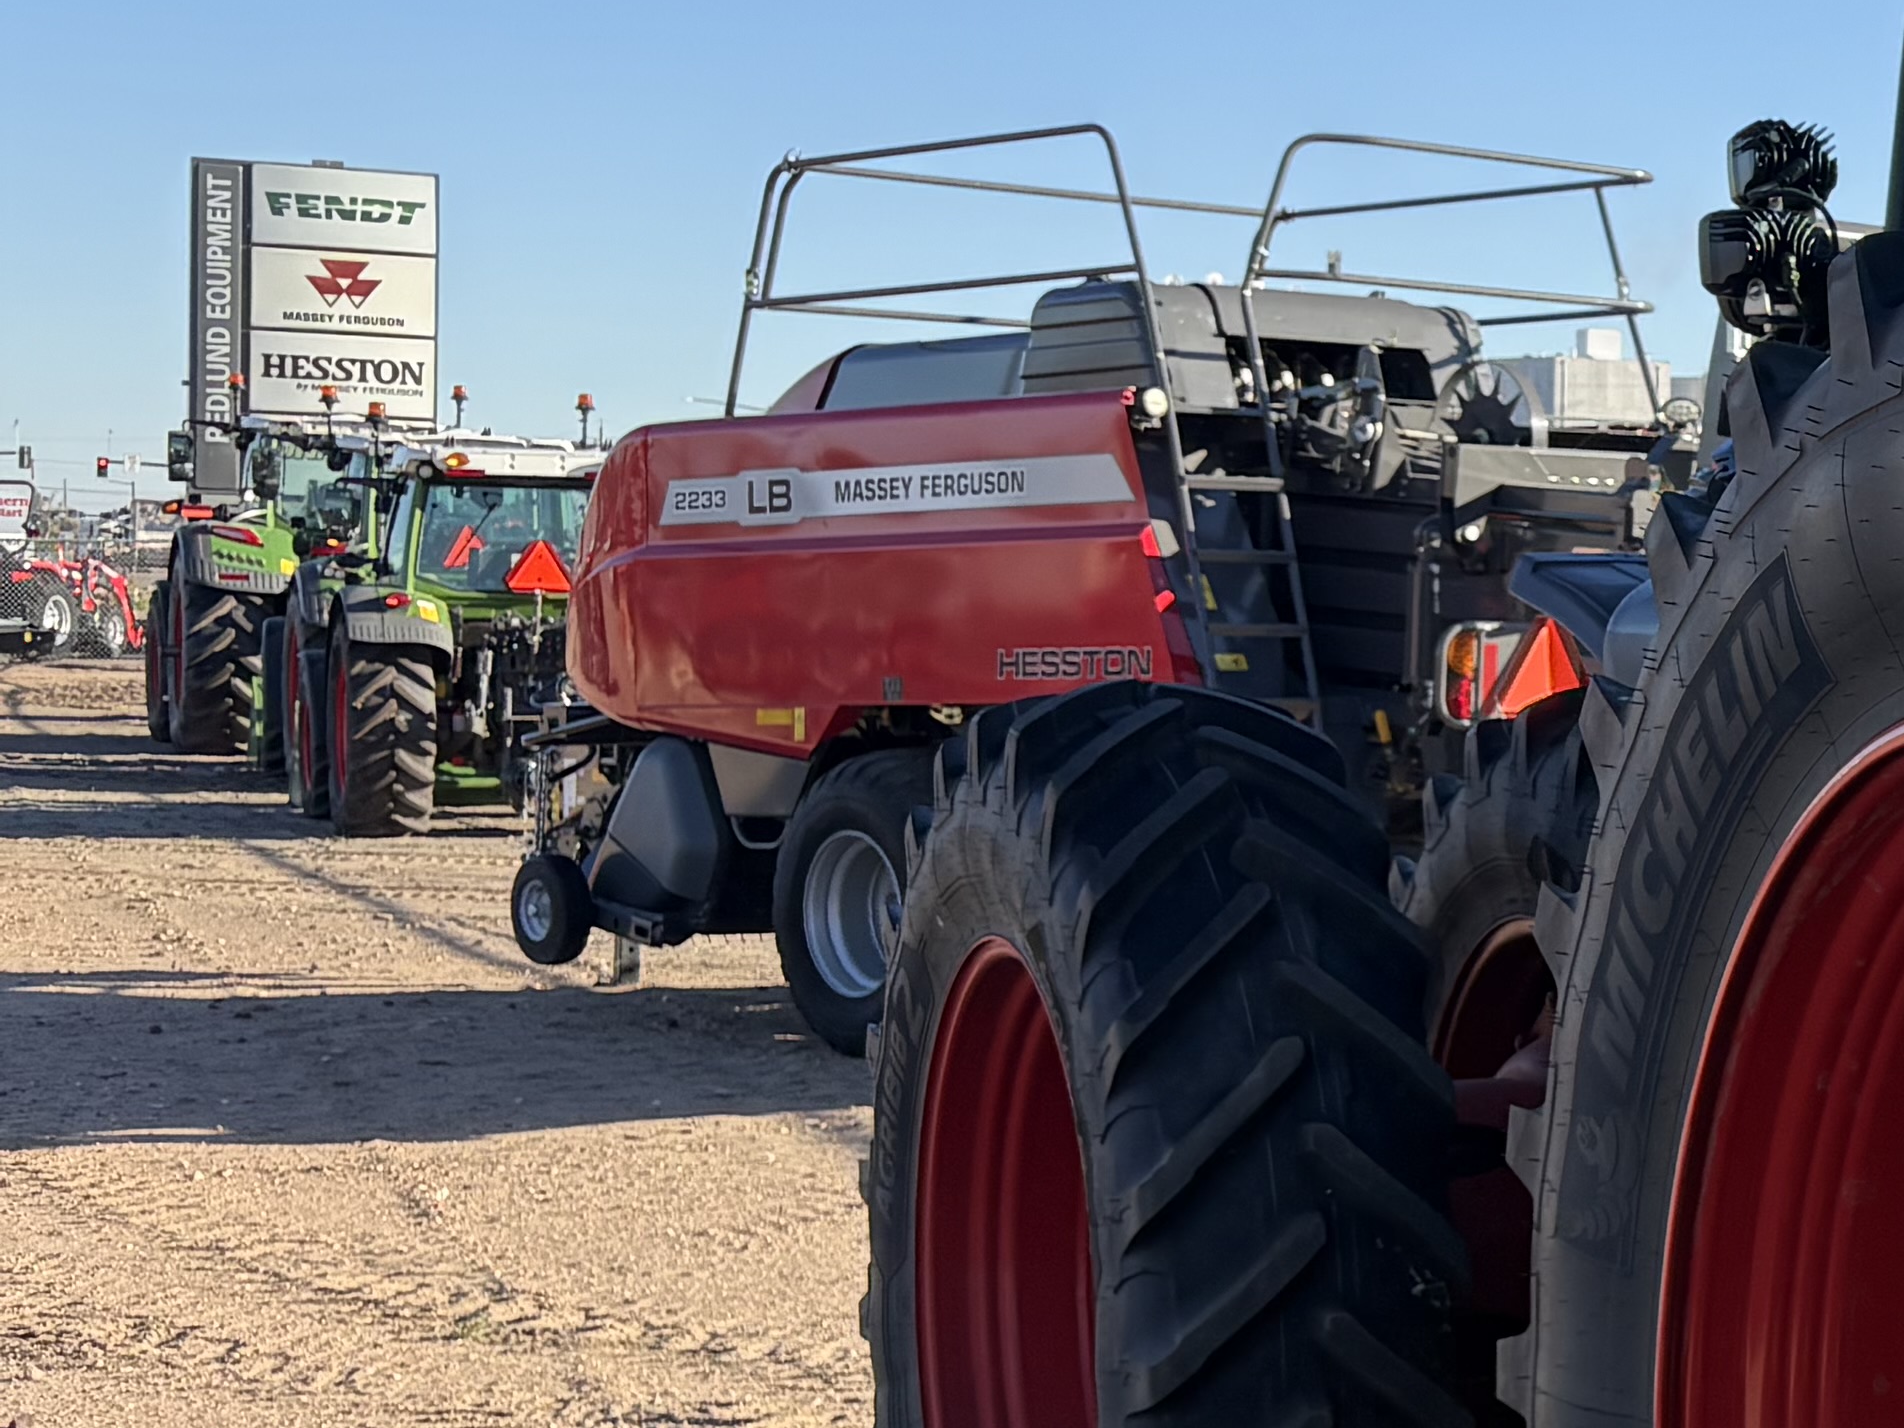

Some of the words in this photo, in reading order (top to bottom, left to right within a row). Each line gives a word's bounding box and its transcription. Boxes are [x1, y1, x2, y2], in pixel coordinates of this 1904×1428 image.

[265, 191, 427, 225] FENDT
[205, 173, 232, 319] EQUIPMENT
[283, 311, 334, 323] MASSEY
[338, 313, 405, 327] FERGUSON
[205, 326, 231, 443] REDLUND
[261, 353, 425, 387] HESSTON
[296, 382, 309, 392] by
[674, 489, 726, 511] 2233
[747, 478, 793, 515] LB
[834, 475, 914, 504] MASSEY
[919, 470, 1026, 499] FERGUSON
[997, 646, 1153, 680] HESSTON
[1588, 576, 1803, 1094] MICHELIN
